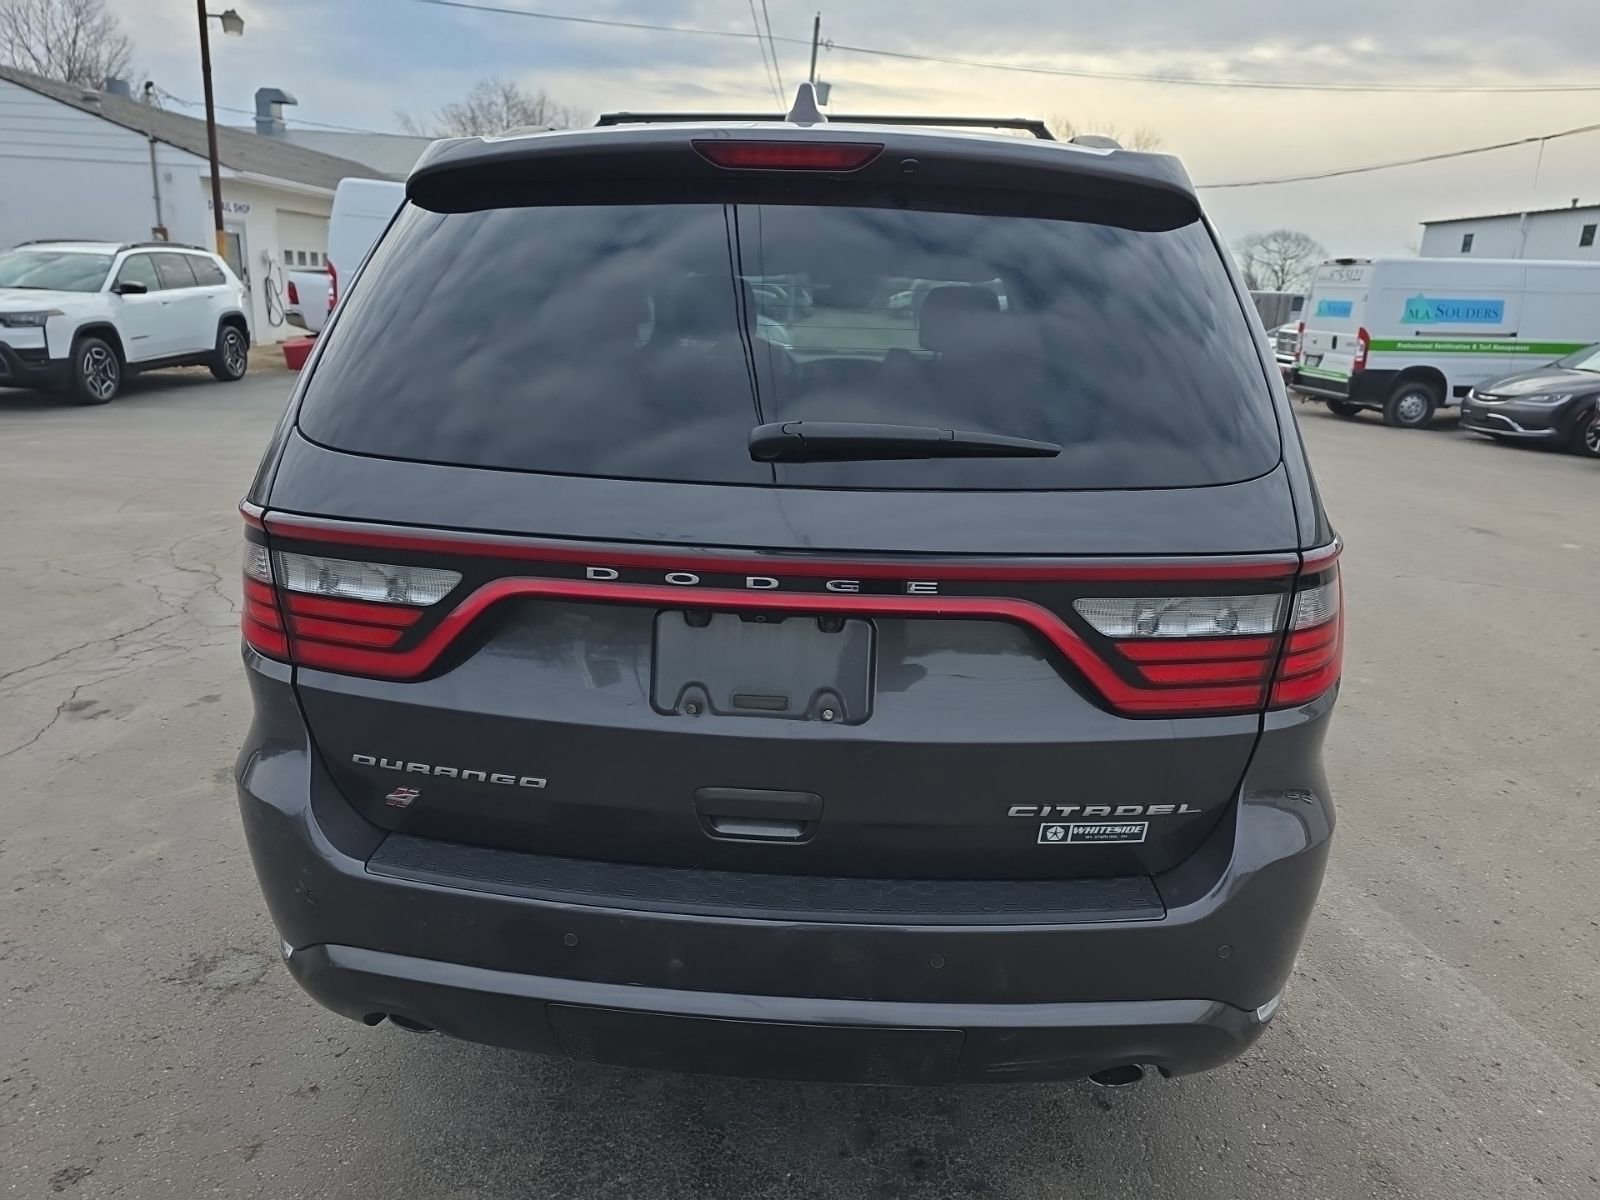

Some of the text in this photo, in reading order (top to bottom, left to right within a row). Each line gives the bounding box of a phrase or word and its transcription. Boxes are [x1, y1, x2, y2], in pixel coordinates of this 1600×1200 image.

[233, 202, 250, 214] SHOP
[586, 566, 939, 595] DODGE
[352, 753, 548, 789] DURANGO
[1007, 804, 1202, 817] CITADEL
[1073, 826, 1144, 834] WHITESIDE
